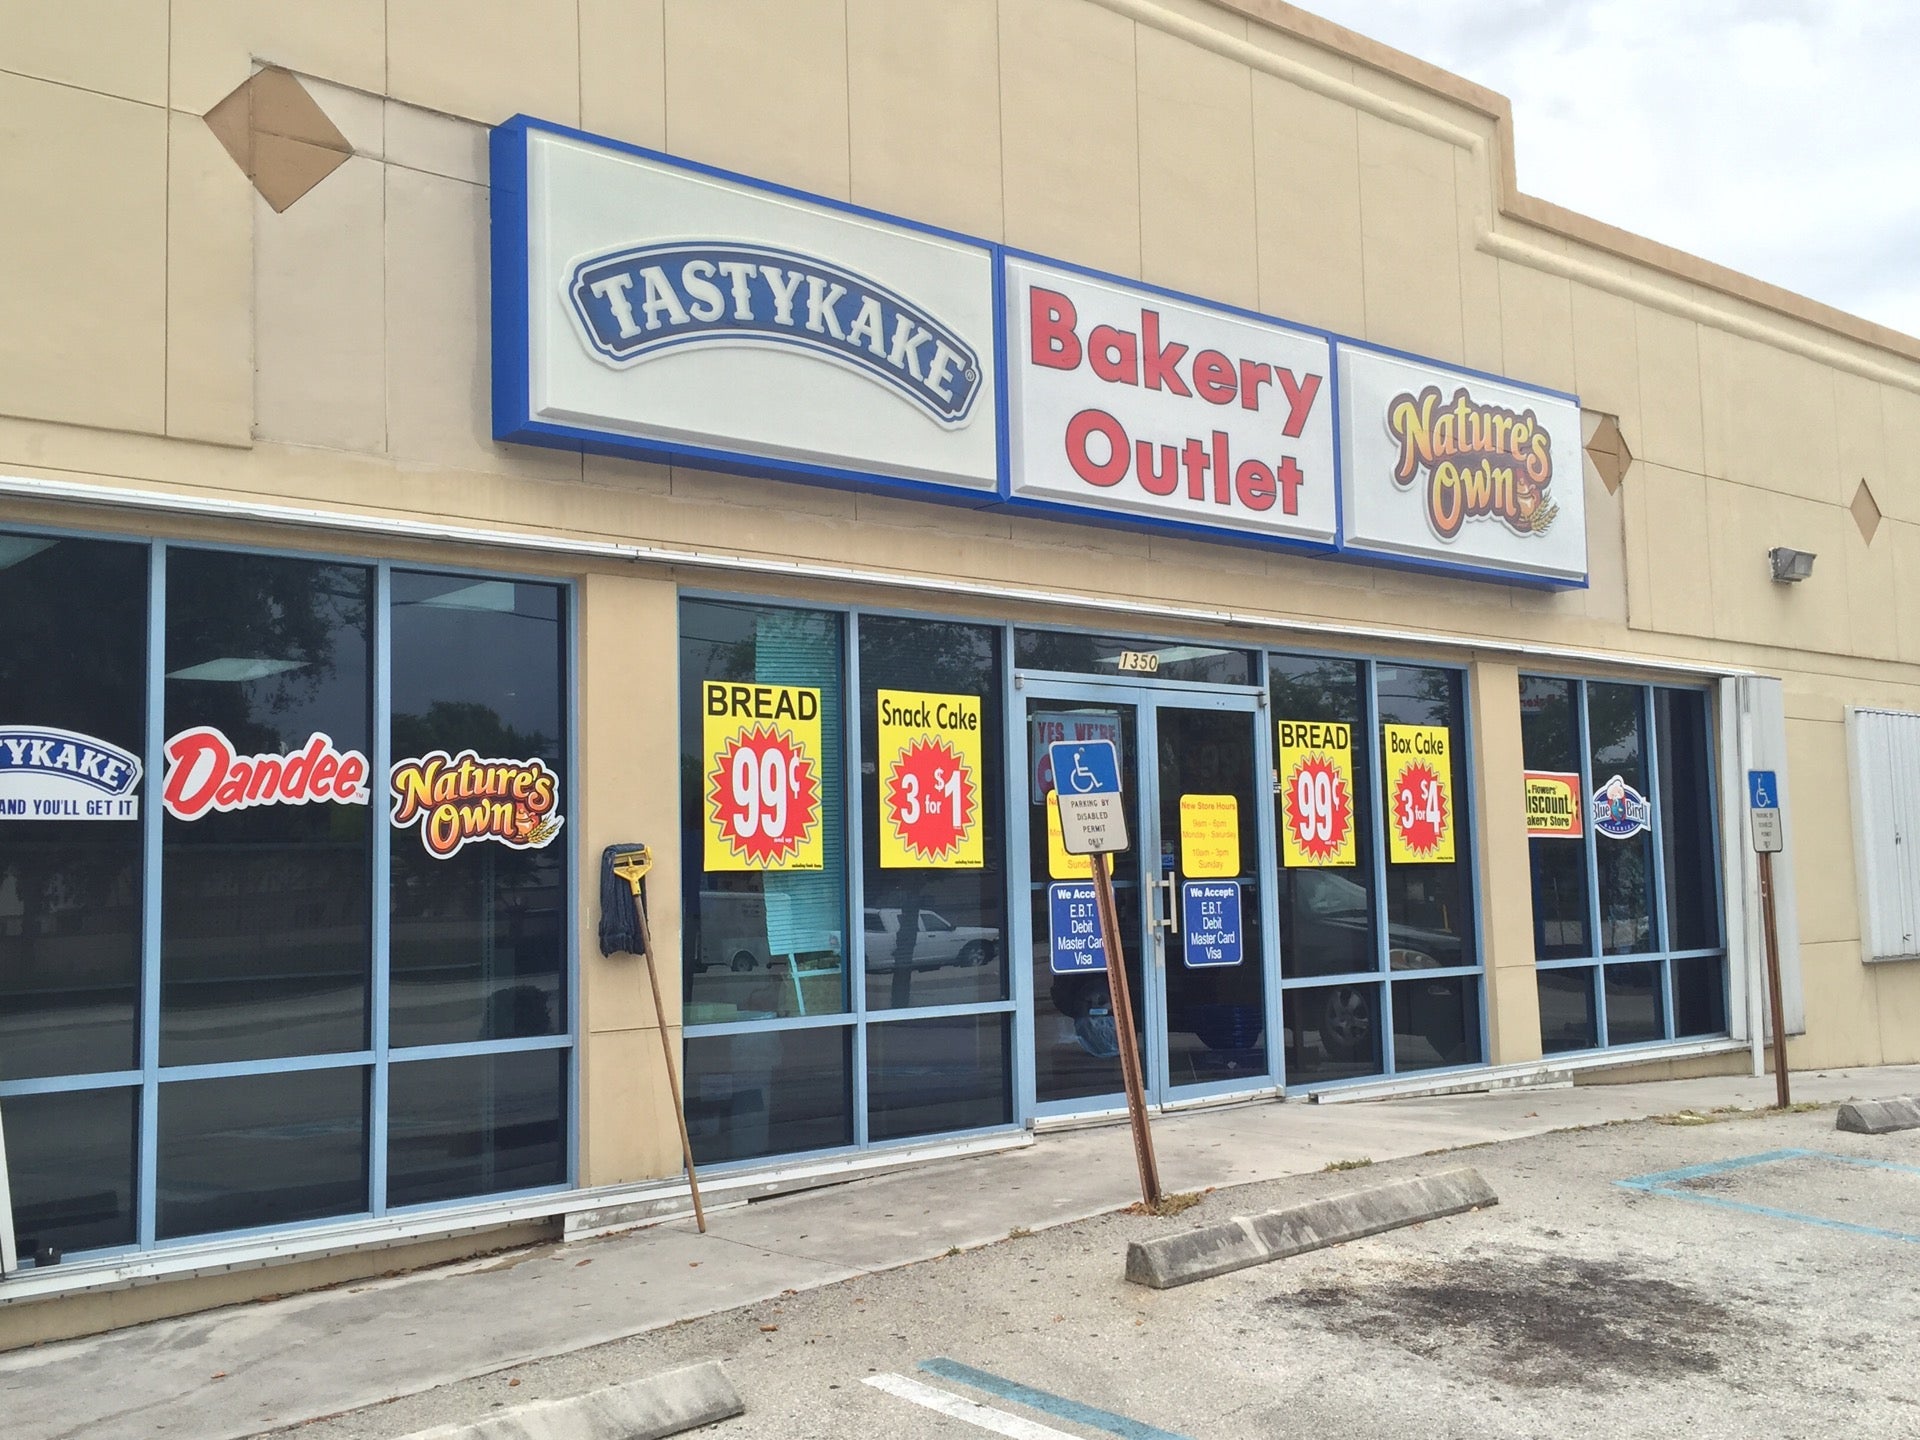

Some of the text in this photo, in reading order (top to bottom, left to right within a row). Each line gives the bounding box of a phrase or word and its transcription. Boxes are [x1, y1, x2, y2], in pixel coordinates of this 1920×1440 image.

[1029, 286, 1323, 438] Bakery
[1391, 392, 1552, 484] Nature's
[1065, 408, 1304, 516] Outlet
[1432, 460, 1517, 532] Own
[1122, 652, 1157, 670] 1350
[707, 685, 818, 721] BREAD
[882, 698, 977, 731] Snack Cake
[1037, 721, 1064, 743] YES
[1281, 724, 1348, 750] BREAD
[1391, 731, 1444, 755] Box Cake
[0, 738, 127, 788] YKAKE
[164, 732, 359, 815] Dandee
[396, 761, 552, 818] Nature's
[901, 767, 961, 828] 3 for $1
[33, 799, 80, 815] YOU'LL
[86, 800, 113, 815] GET
[119, 800, 133, 816] IT
[1071, 799, 1110, 808] PARKING BY
[1181, 801, 1236, 810] New Store Hours
[1401, 789, 1414, 829] 3
[1415, 806, 1426, 821] for
[1625, 800, 1644, 820] Bird
[1077, 812, 1108, 821] DISABLED
[1527, 815, 1570, 827] akery Store
[427, 798, 512, 854] Own
[1083, 825, 1106, 833] PERMIT
[1088, 838, 1104, 846] ONLY
[1067, 860, 1093, 869] Sunda
[1057, 889, 1096, 900] We Acce
[1190, 888, 1203, 898] We
[1069, 903, 1094, 918] E.B.T.
[1201, 901, 1223, 915] E.B.T.
[1071, 920, 1093, 934] Debit
[1202, 916, 1222, 930] Debit
[1058, 935, 1103, 950] Master Car
[1191, 930, 1235, 945] Master Card
[1074, 951, 1093, 965] Visa
[1205, 946, 1222, 960] Visa
